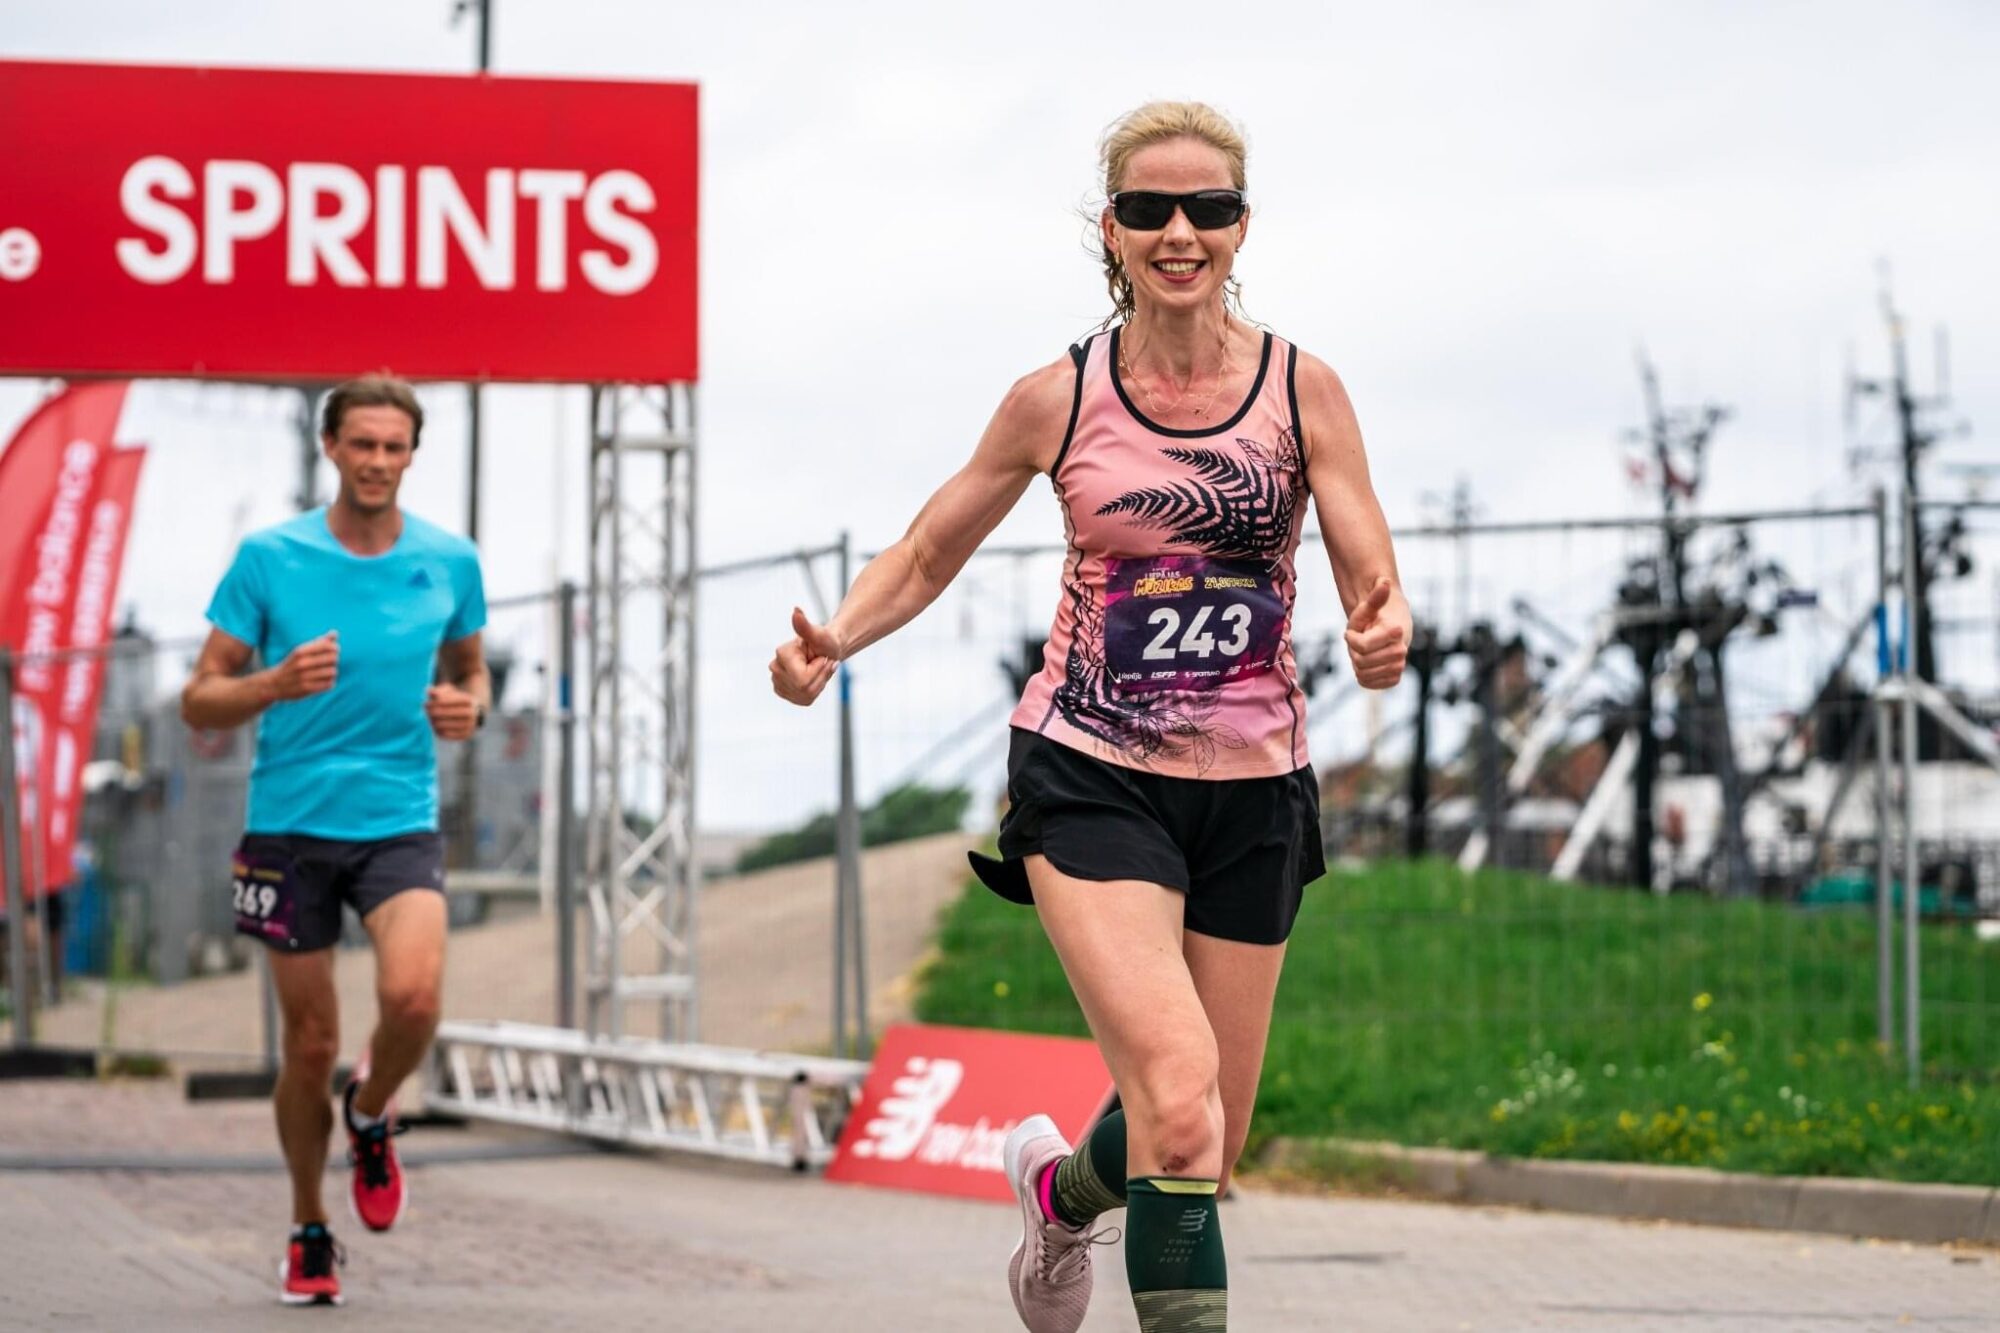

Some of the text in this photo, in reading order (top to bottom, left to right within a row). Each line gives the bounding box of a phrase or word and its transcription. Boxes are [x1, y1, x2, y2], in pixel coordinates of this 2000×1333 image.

[115, 154, 660, 296] SPRINTS
[1142, 603, 1252, 660] 243
[233, 880, 278, 918] 269
